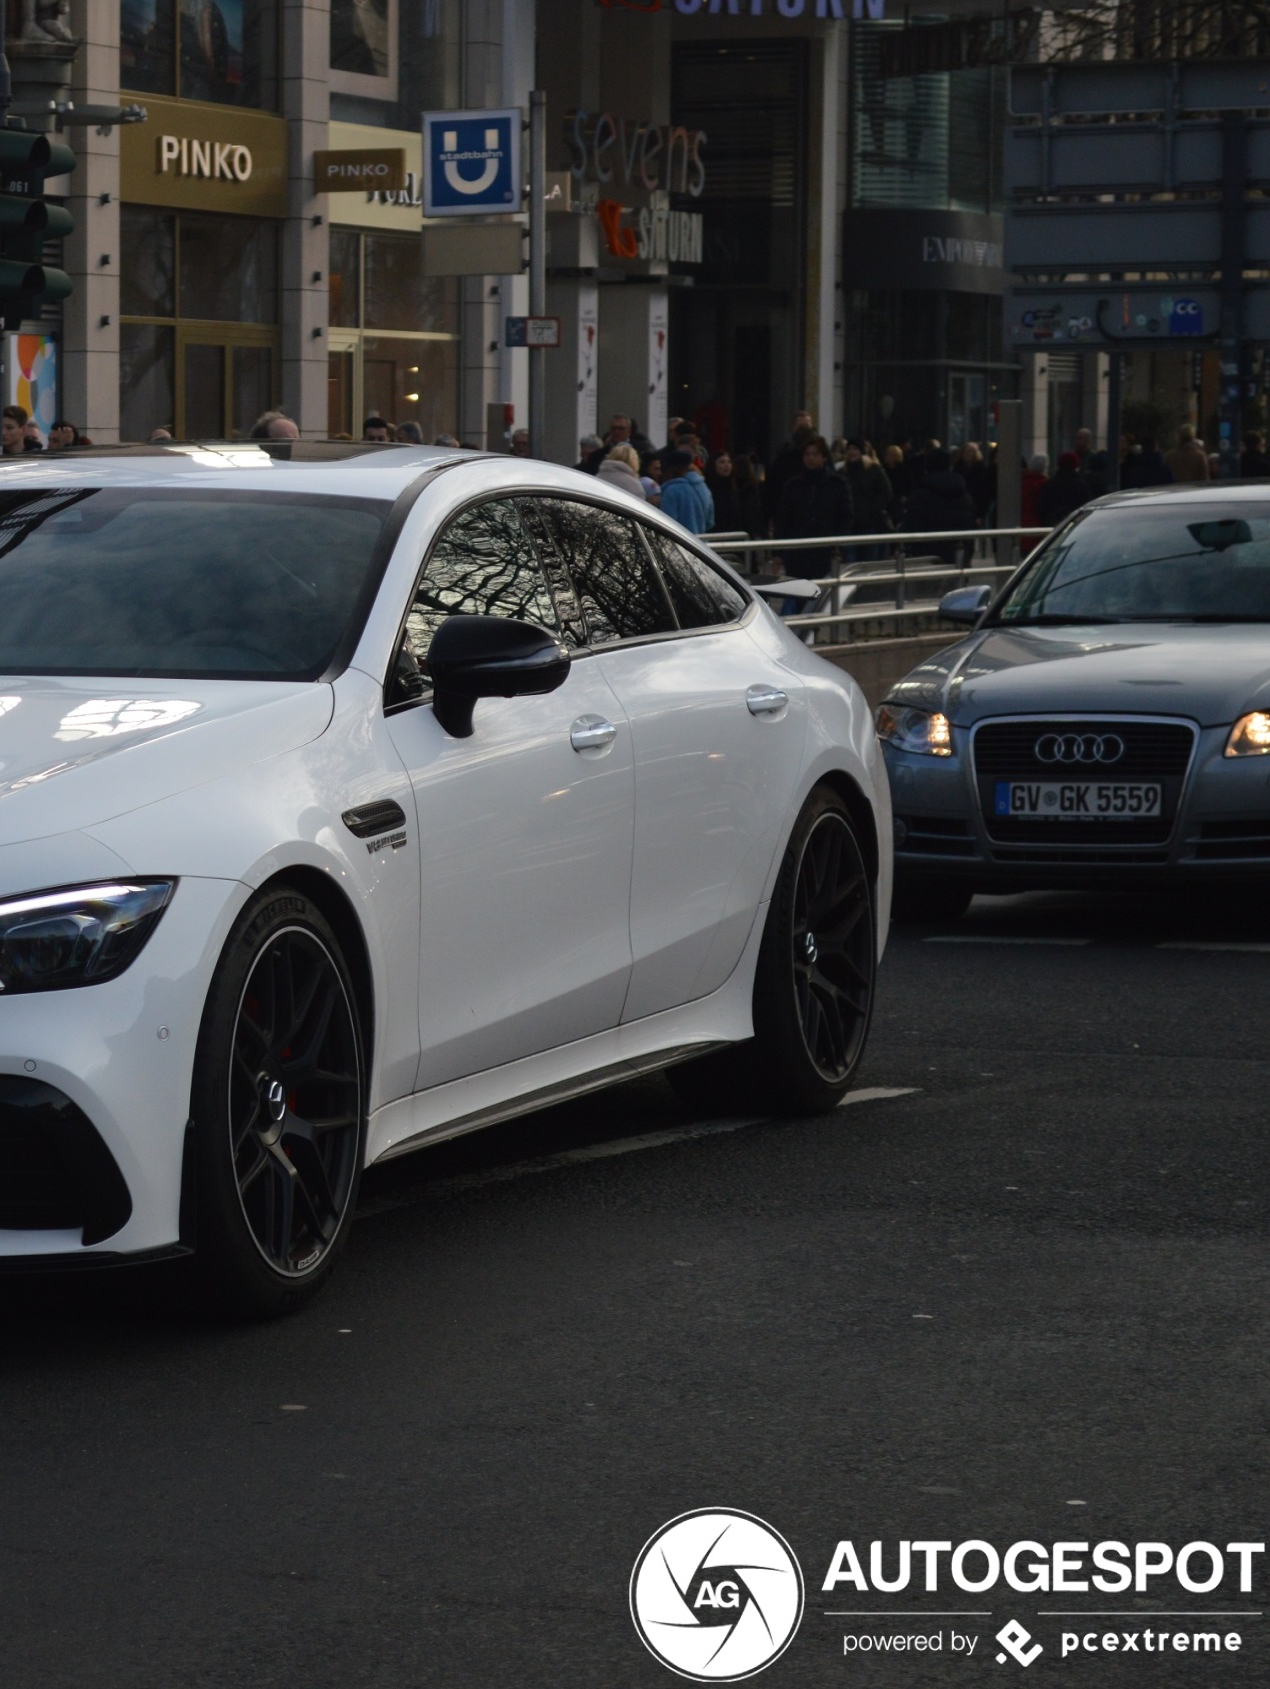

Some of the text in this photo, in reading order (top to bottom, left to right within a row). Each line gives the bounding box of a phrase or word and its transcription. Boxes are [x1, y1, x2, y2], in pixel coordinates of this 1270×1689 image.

[161, 134, 253, 182] PINKO
[439, 150, 504, 161] stadtbahn
[327, 163, 389, 177] PINKO
[1011, 785, 1158, 813] GV GK 5559
